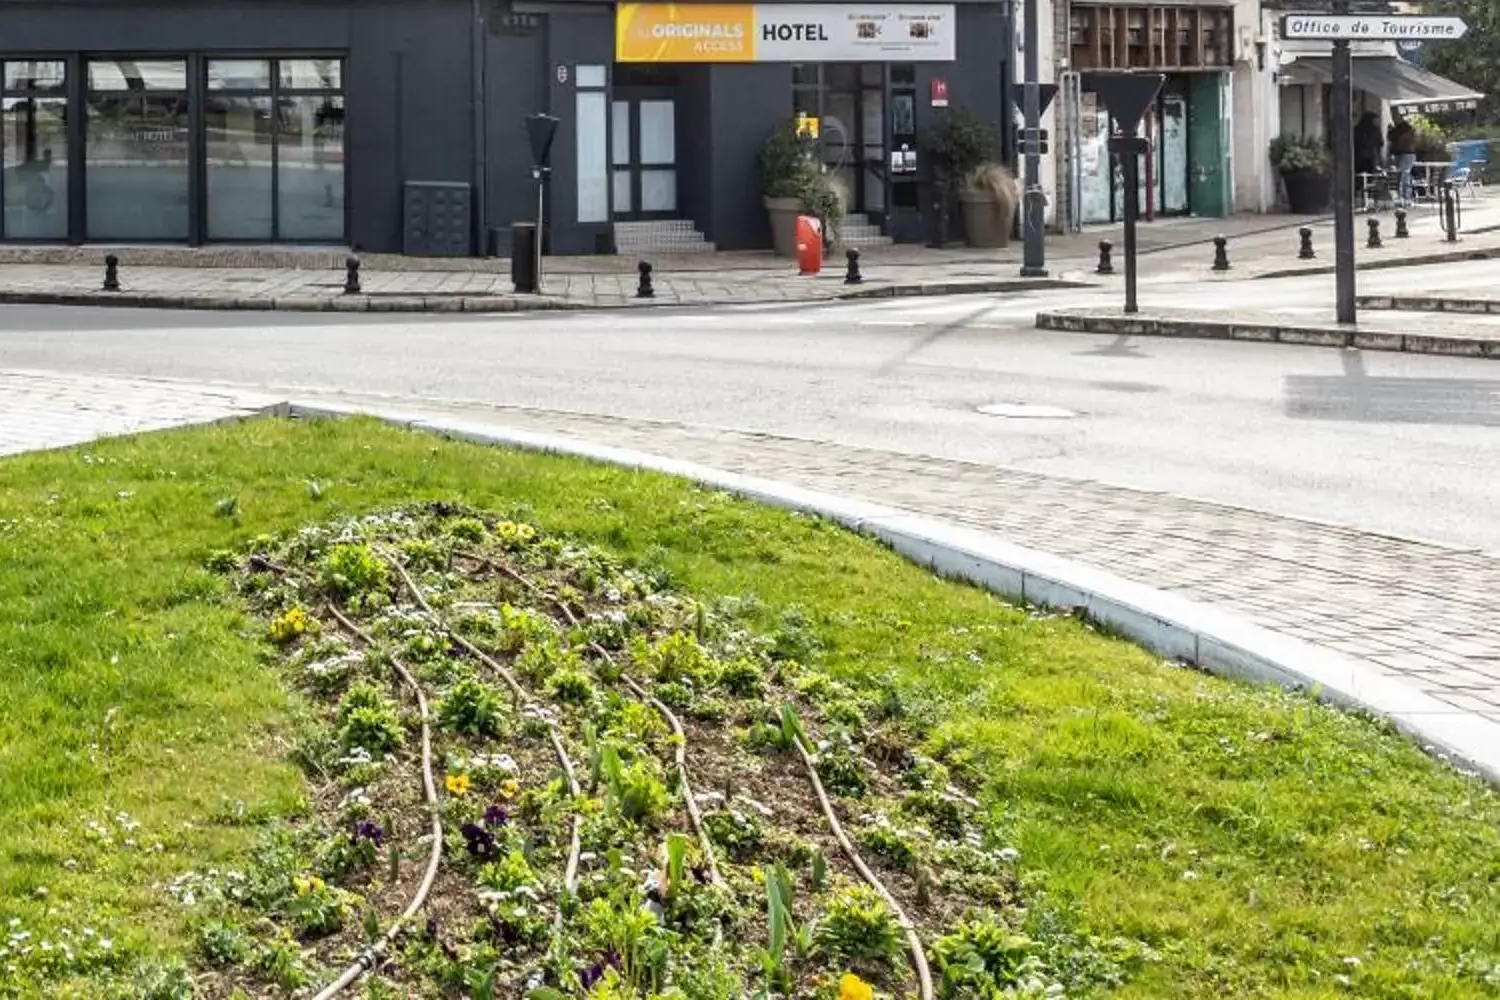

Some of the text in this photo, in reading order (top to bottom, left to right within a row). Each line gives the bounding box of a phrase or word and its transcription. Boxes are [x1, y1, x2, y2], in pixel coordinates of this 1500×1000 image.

[651, 23, 744, 39] ORIGINALS
[762, 23, 829, 41] HOTEL
[1291, 20, 1455, 34] Office de Tourisme
